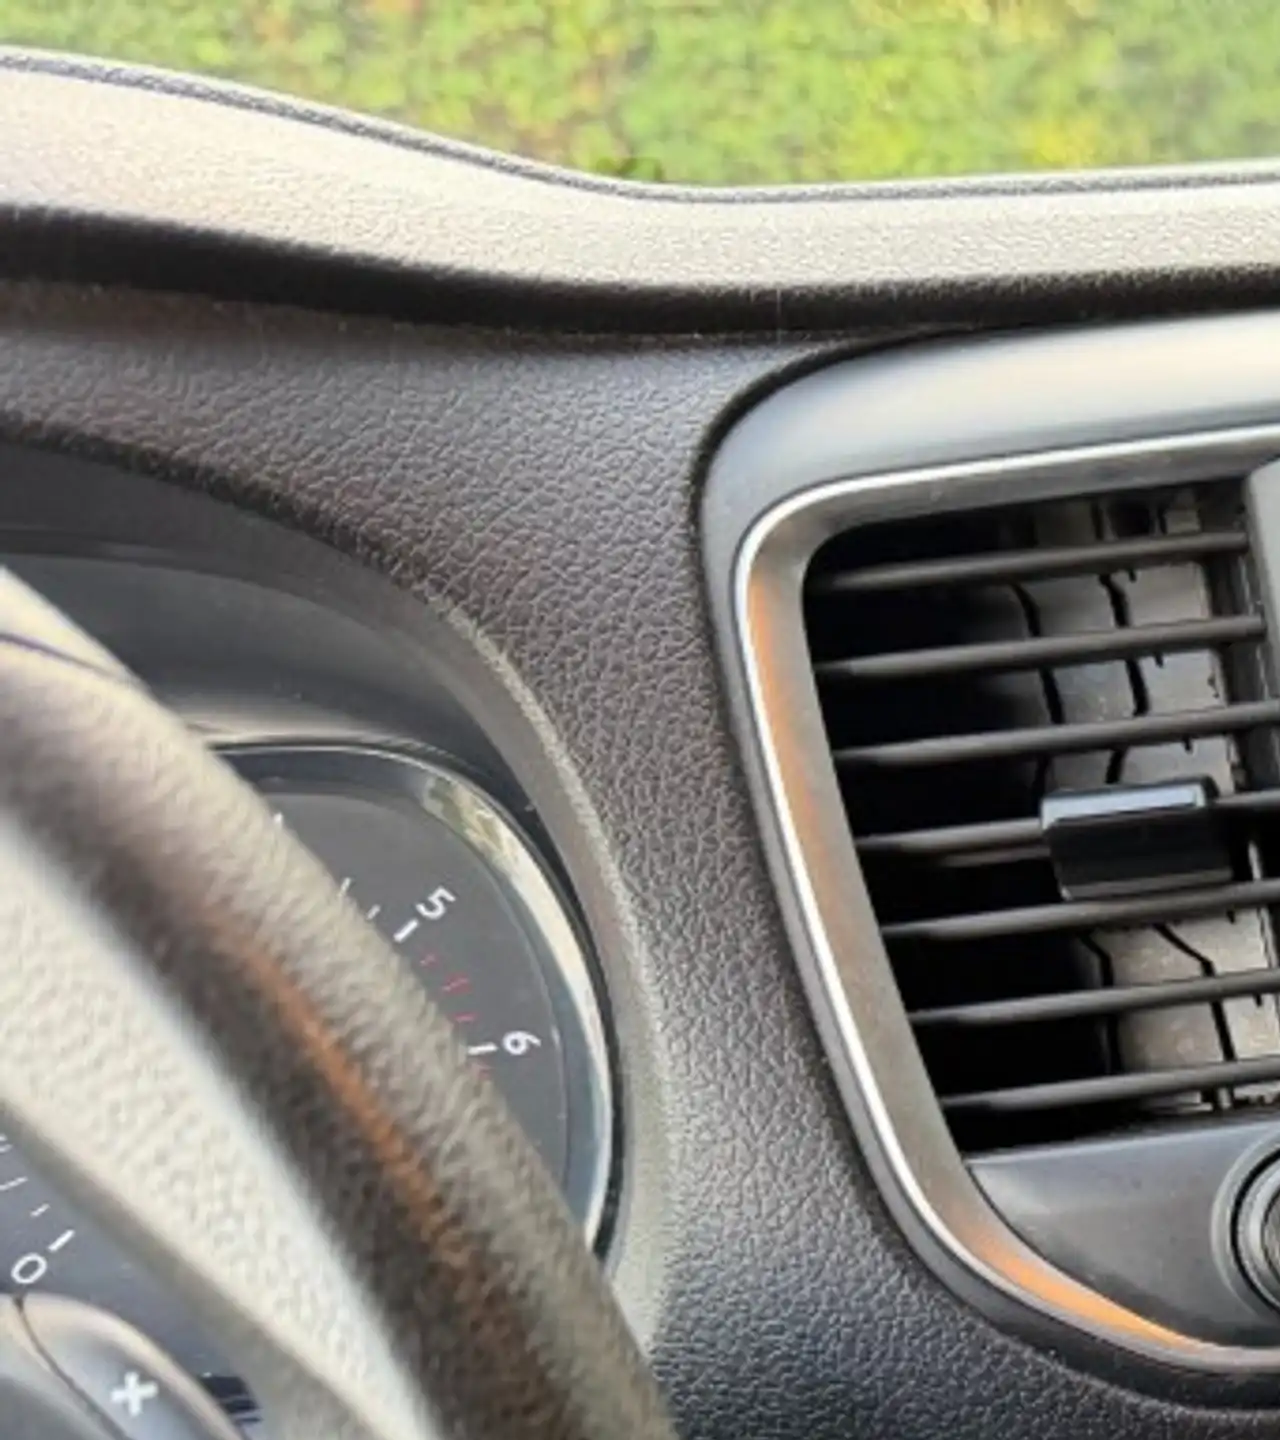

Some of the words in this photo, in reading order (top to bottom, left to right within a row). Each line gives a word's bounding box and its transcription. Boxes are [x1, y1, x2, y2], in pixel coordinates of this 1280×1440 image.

[416, 886, 456, 919] 5
[503, 1031, 542, 1056] 6
[11, 1253, 48, 1285] 0
